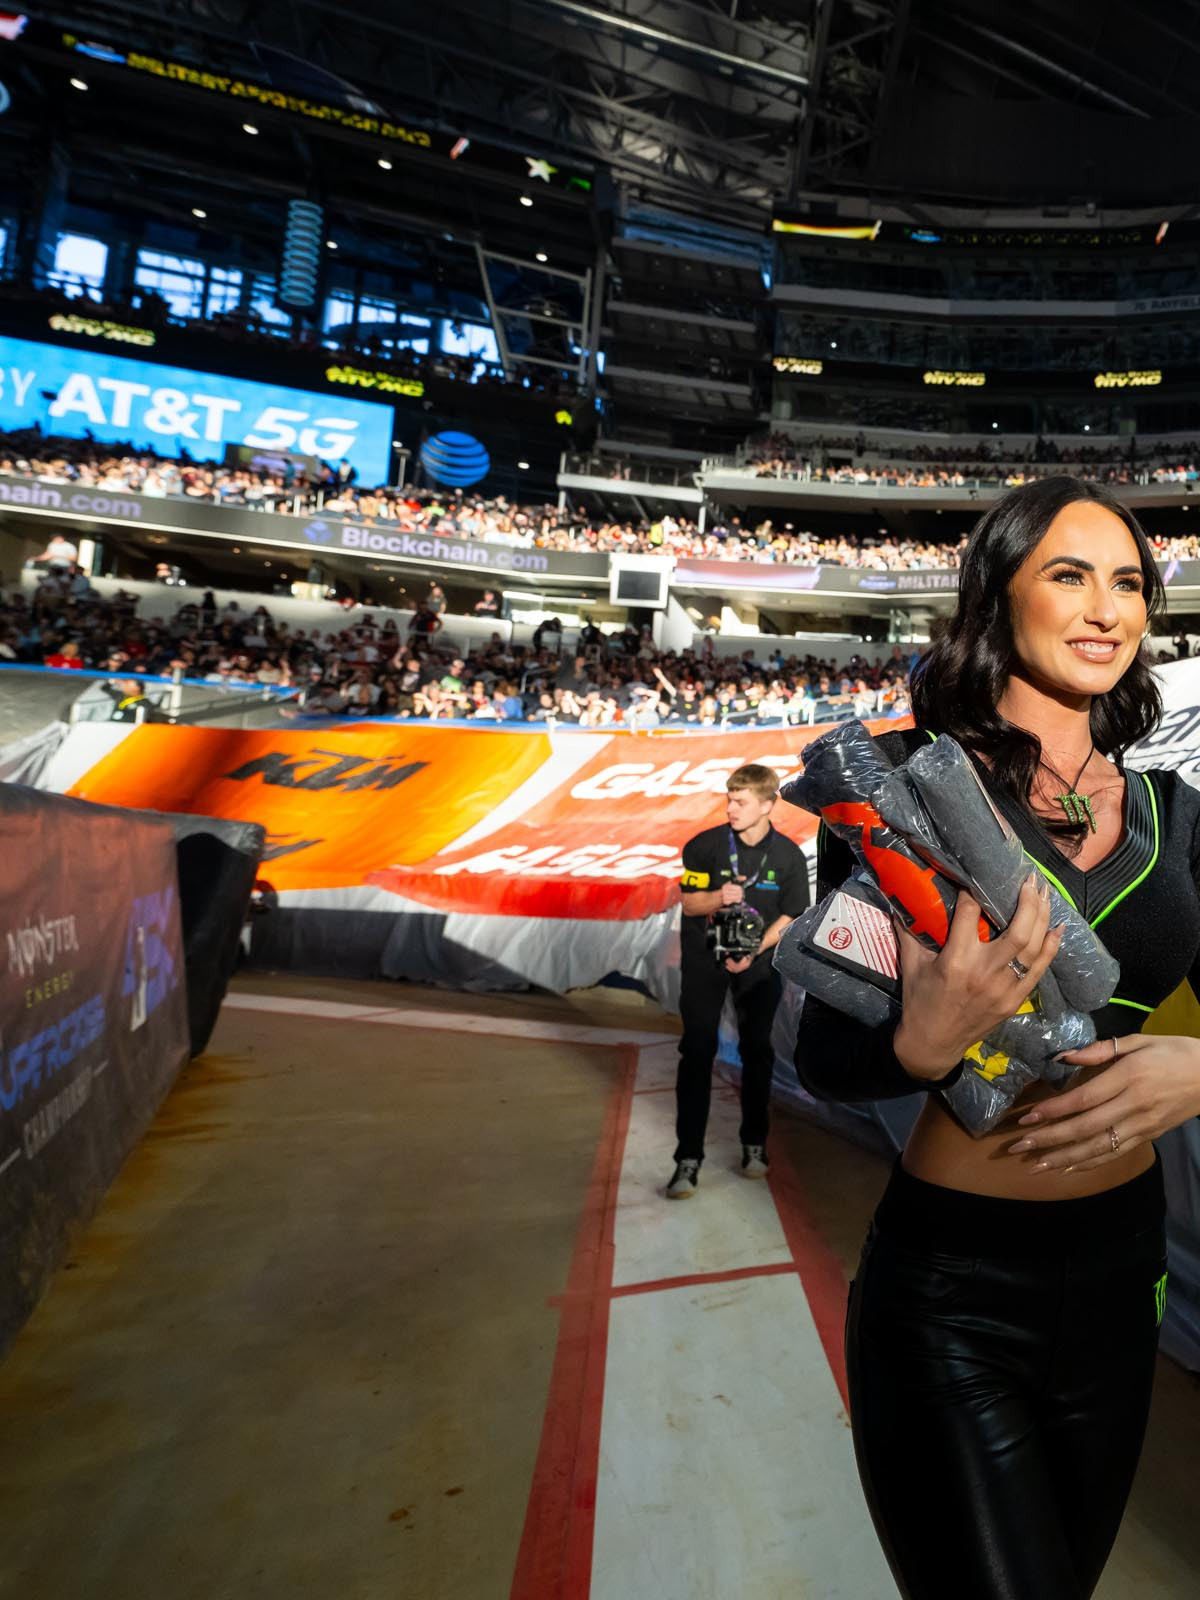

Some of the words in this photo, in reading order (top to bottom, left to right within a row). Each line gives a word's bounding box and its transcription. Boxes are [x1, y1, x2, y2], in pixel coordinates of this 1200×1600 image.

[0, 366, 36, 407] Y
[48, 373, 241, 442] AT&T
[243, 406, 359, 460] 5G
[341, 526, 548, 571] Blockchain.com
[898, 573, 960, 590] MILITAR
[224, 749, 431, 792] KTM
[6, 913, 79, 977] MONSTER
[25, 970, 73, 1008] ENERG
